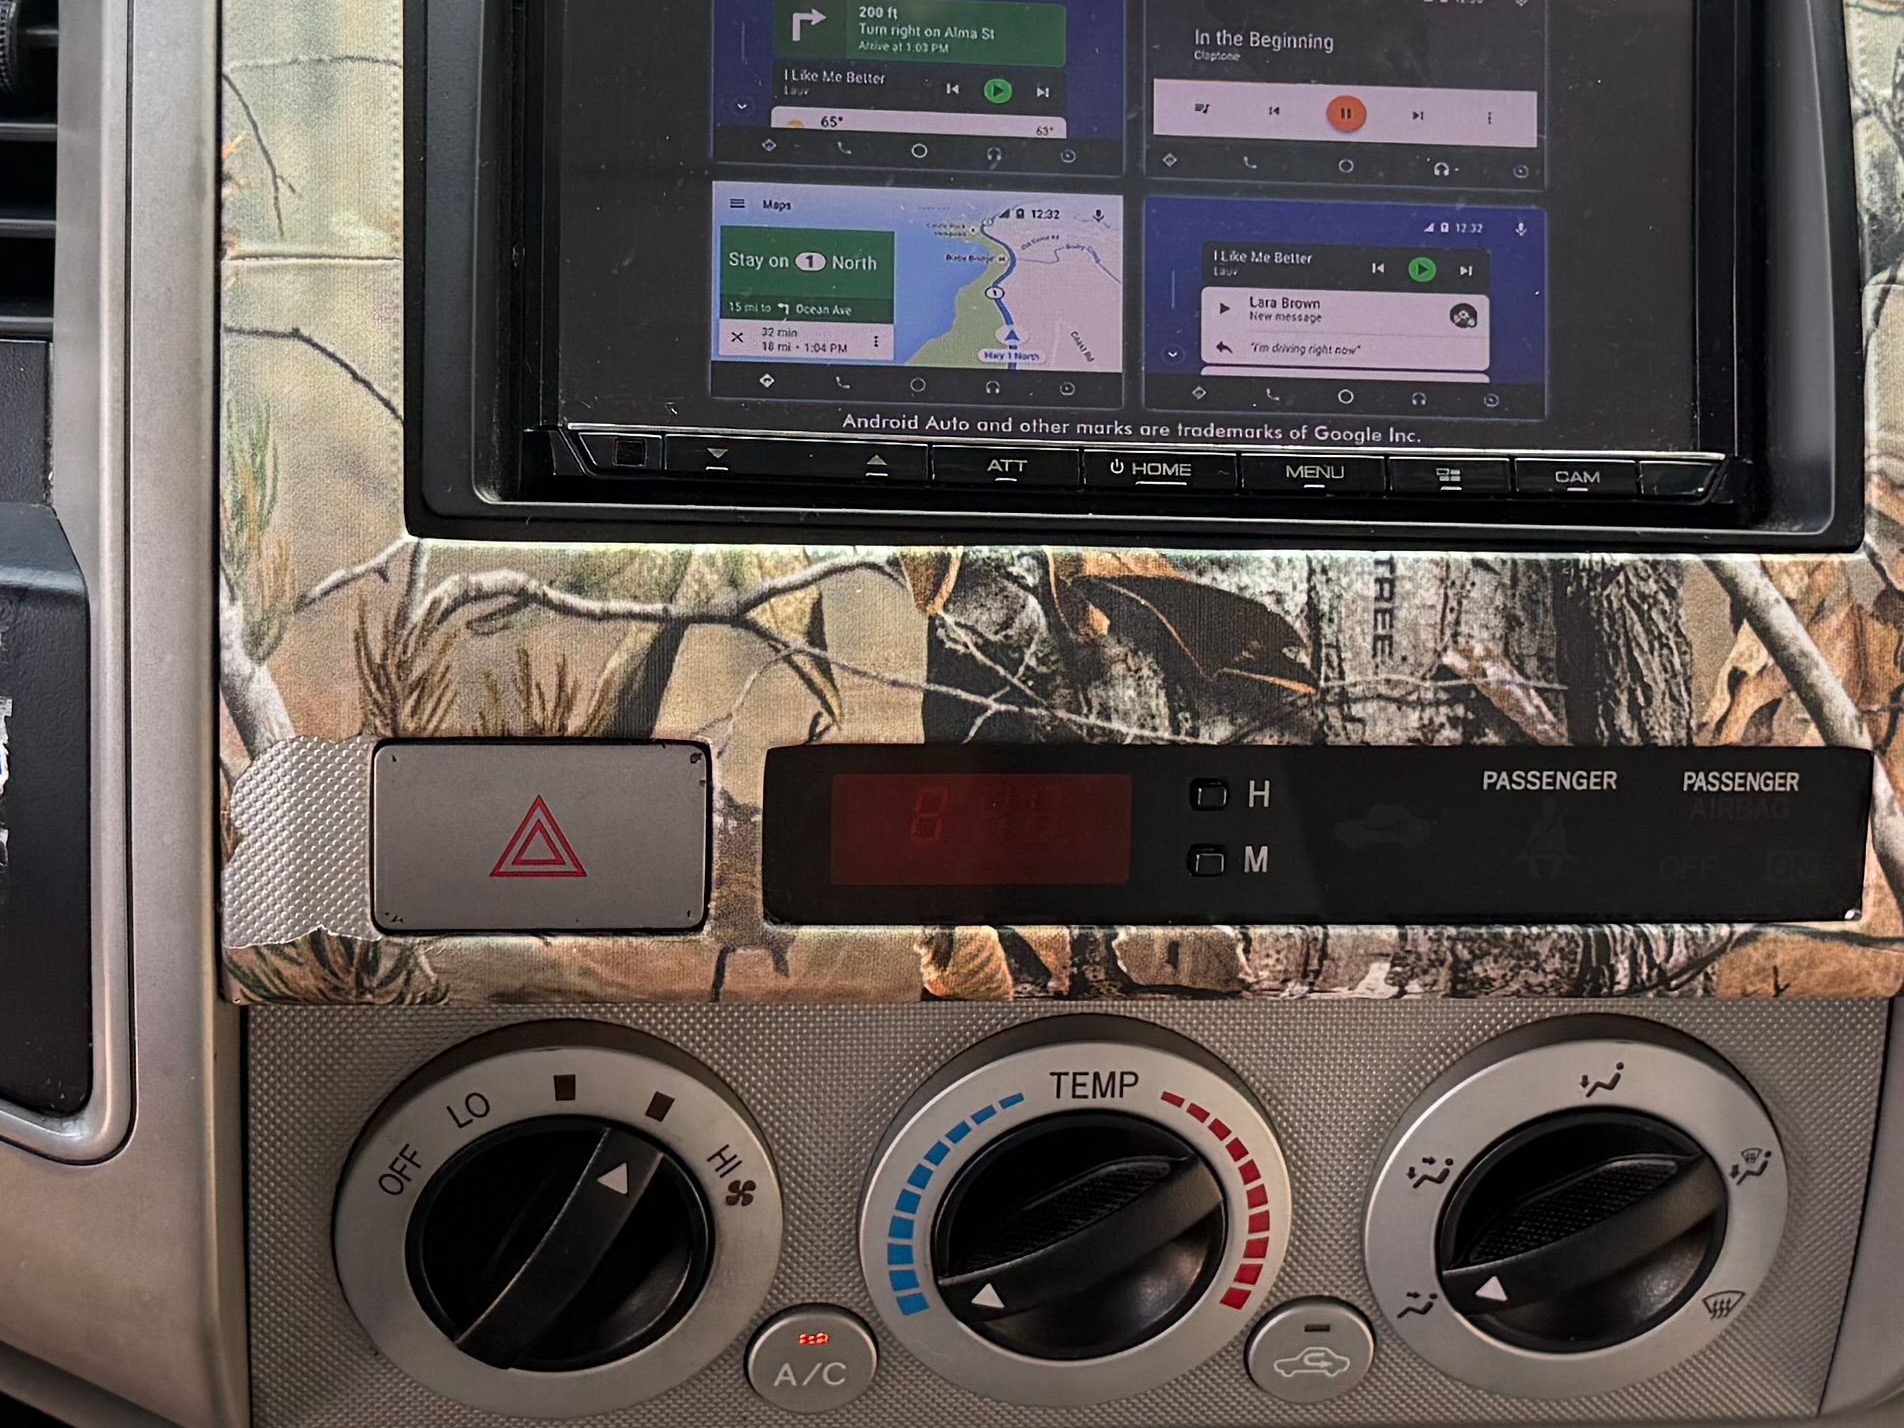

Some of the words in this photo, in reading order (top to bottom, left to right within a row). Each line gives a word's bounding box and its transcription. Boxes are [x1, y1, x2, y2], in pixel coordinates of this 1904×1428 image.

[859, 7, 883, 19] 200
[887, 6, 898, 20] ft
[859, 22, 887, 36] Turn
[891, 23, 920, 40] right
[924, 28, 941, 38] on
[944, 27, 977, 41] Alma
[981, 28, 995, 41] St
[892, 43, 904, 52] at
[930, 43, 949, 53] PM
[1194, 29, 1210, 45] In
[1216, 29, 1243, 46] the
[1249, 31, 1334, 54] Beginning
[792, 69, 819, 82] Like
[822, 71, 843, 83] Me
[846, 72, 885, 84] Better
[762, 199, 792, 212] Maps
[1031, 209, 1060, 220] 12:32
[729, 252, 764, 270] Stay
[769, 255, 789, 268] on
[805, 255, 814, 268] 1
[832, 256, 877, 271] North
[1221, 251, 1247, 263] Like
[1251, 252, 1271, 263] Me
[1274, 252, 1313, 265] Better
[729, 302, 742, 313] 15
[744, 303, 758, 313] mi
[760, 304, 772, 313] to
[796, 304, 829, 315] Ocean
[832, 305, 852, 316] Ave
[1250, 297, 1277, 309] Lara
[1282, 298, 1320, 310] Brown
[1250, 312, 1272, 321] New
[1276, 313, 1322, 324] message
[777, 328, 798, 338] min
[777, 342, 791, 352] mi
[804, 343, 827, 353] 1:04
[830, 344, 848, 354] PM
[1273, 343, 1306, 356] driving
[1308, 344, 1332, 356] right
[843, 414, 919, 430] Android
[925, 415, 970, 431] Auto
[977, 417, 1013, 433] and
[1020, 418, 1071, 434] other
[1076, 420, 1133, 436] marks
[1140, 424, 1170, 437] are
[1178, 422, 1283, 439] trademarks
[1289, 424, 1308, 440] of
[1314, 425, 1382, 444] Google
[1389, 427, 1422, 443] Inc.
[987, 459, 1028, 473] ATT
[1132, 462, 1192, 476] HOME
[1286, 465, 1345, 479] MENU
[1555, 470, 1601, 484] CAM
[1482, 770, 1618, 792] PASSENGER
[1682, 770, 1800, 793] PASSENGER
[1248, 780, 1271, 808] H
[1243, 847, 1269, 874] M
[1048, 1070, 1140, 1099] TEMP
[447, 1090, 492, 1131] LO
[705, 1143, 743, 1180] HI
[377, 1142, 426, 1199] OFF
[773, 1361, 847, 1389] A/C
